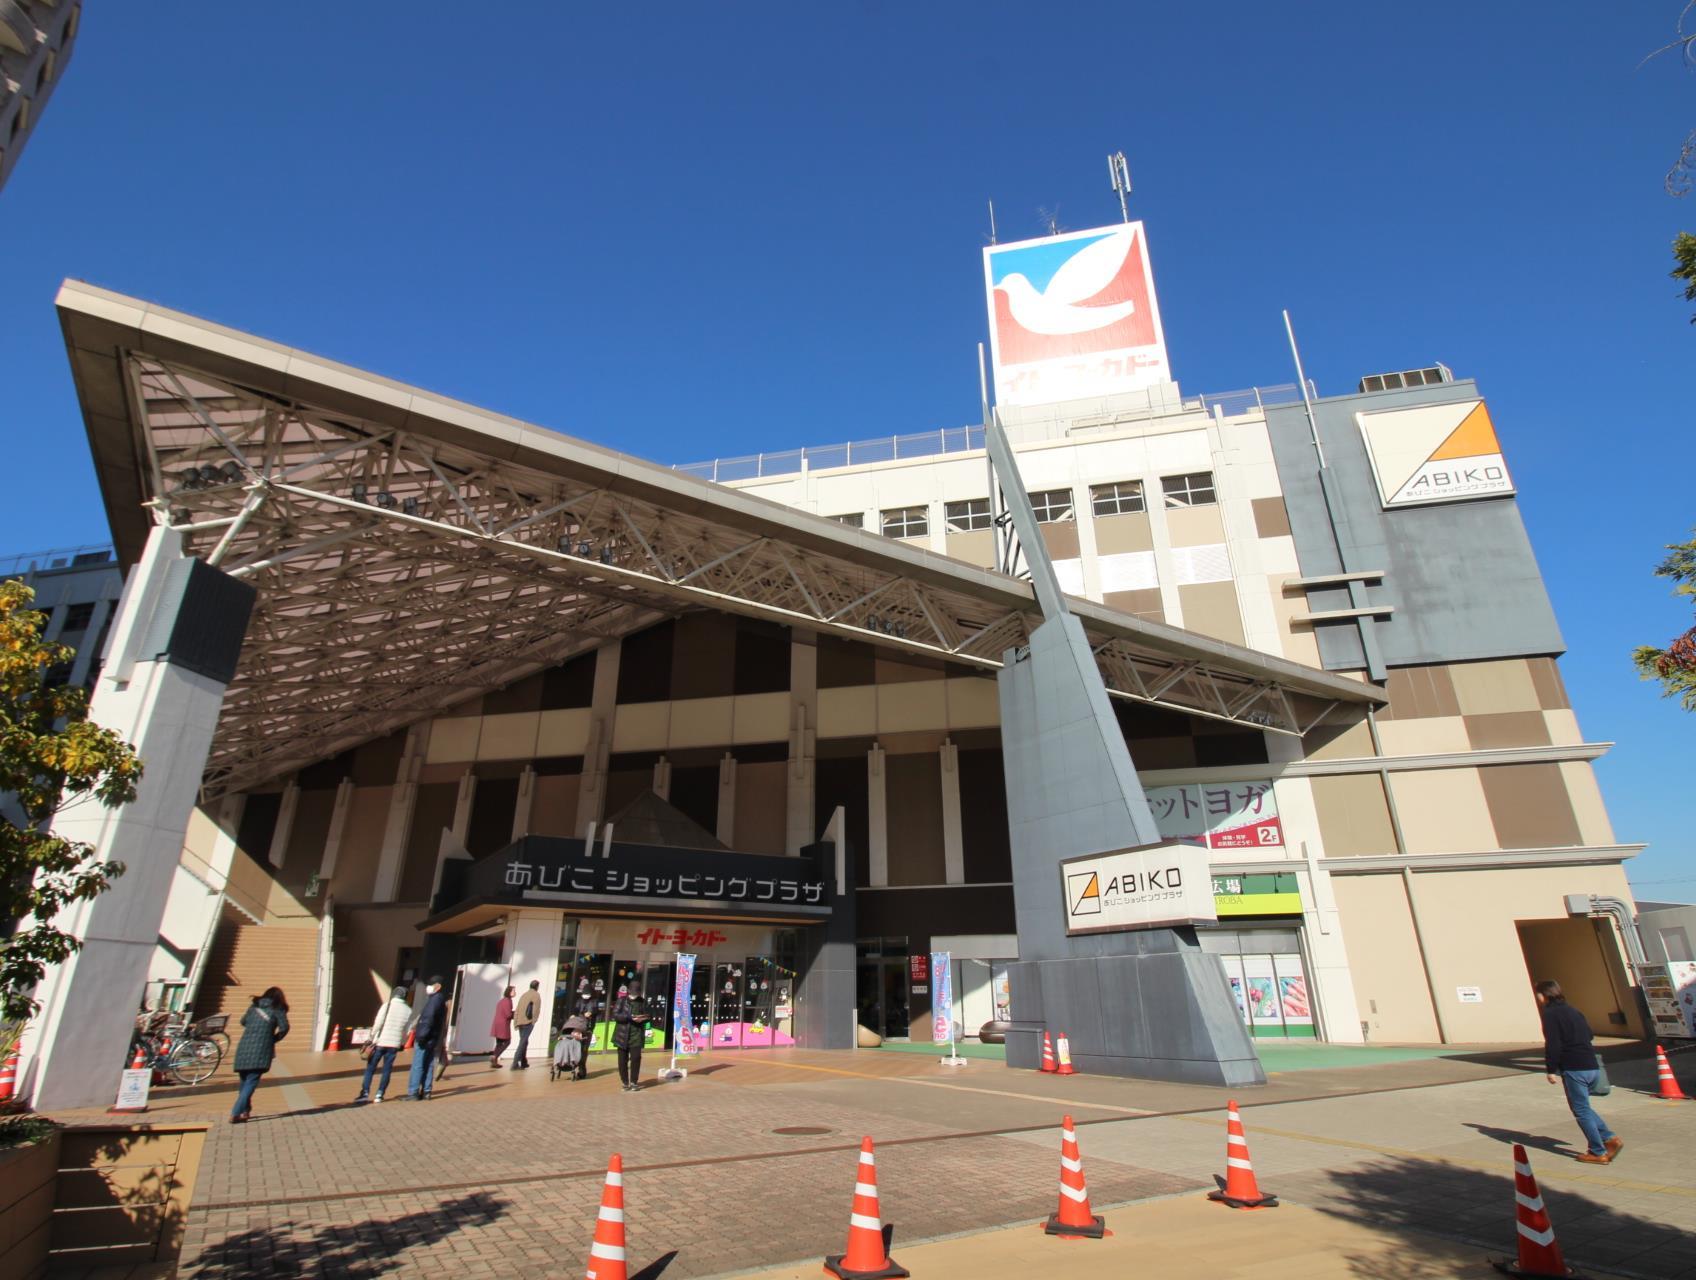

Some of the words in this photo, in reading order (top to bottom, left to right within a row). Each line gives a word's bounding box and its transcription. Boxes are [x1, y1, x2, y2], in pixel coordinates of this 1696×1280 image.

[1412, 466, 1503, 488] ABIKO
[505, 861, 825, 902] あびこショッピングプラザ
[1104, 867, 1182, 896] ABIKO
[636, 927, 727, 947] イトーヨーカドー
